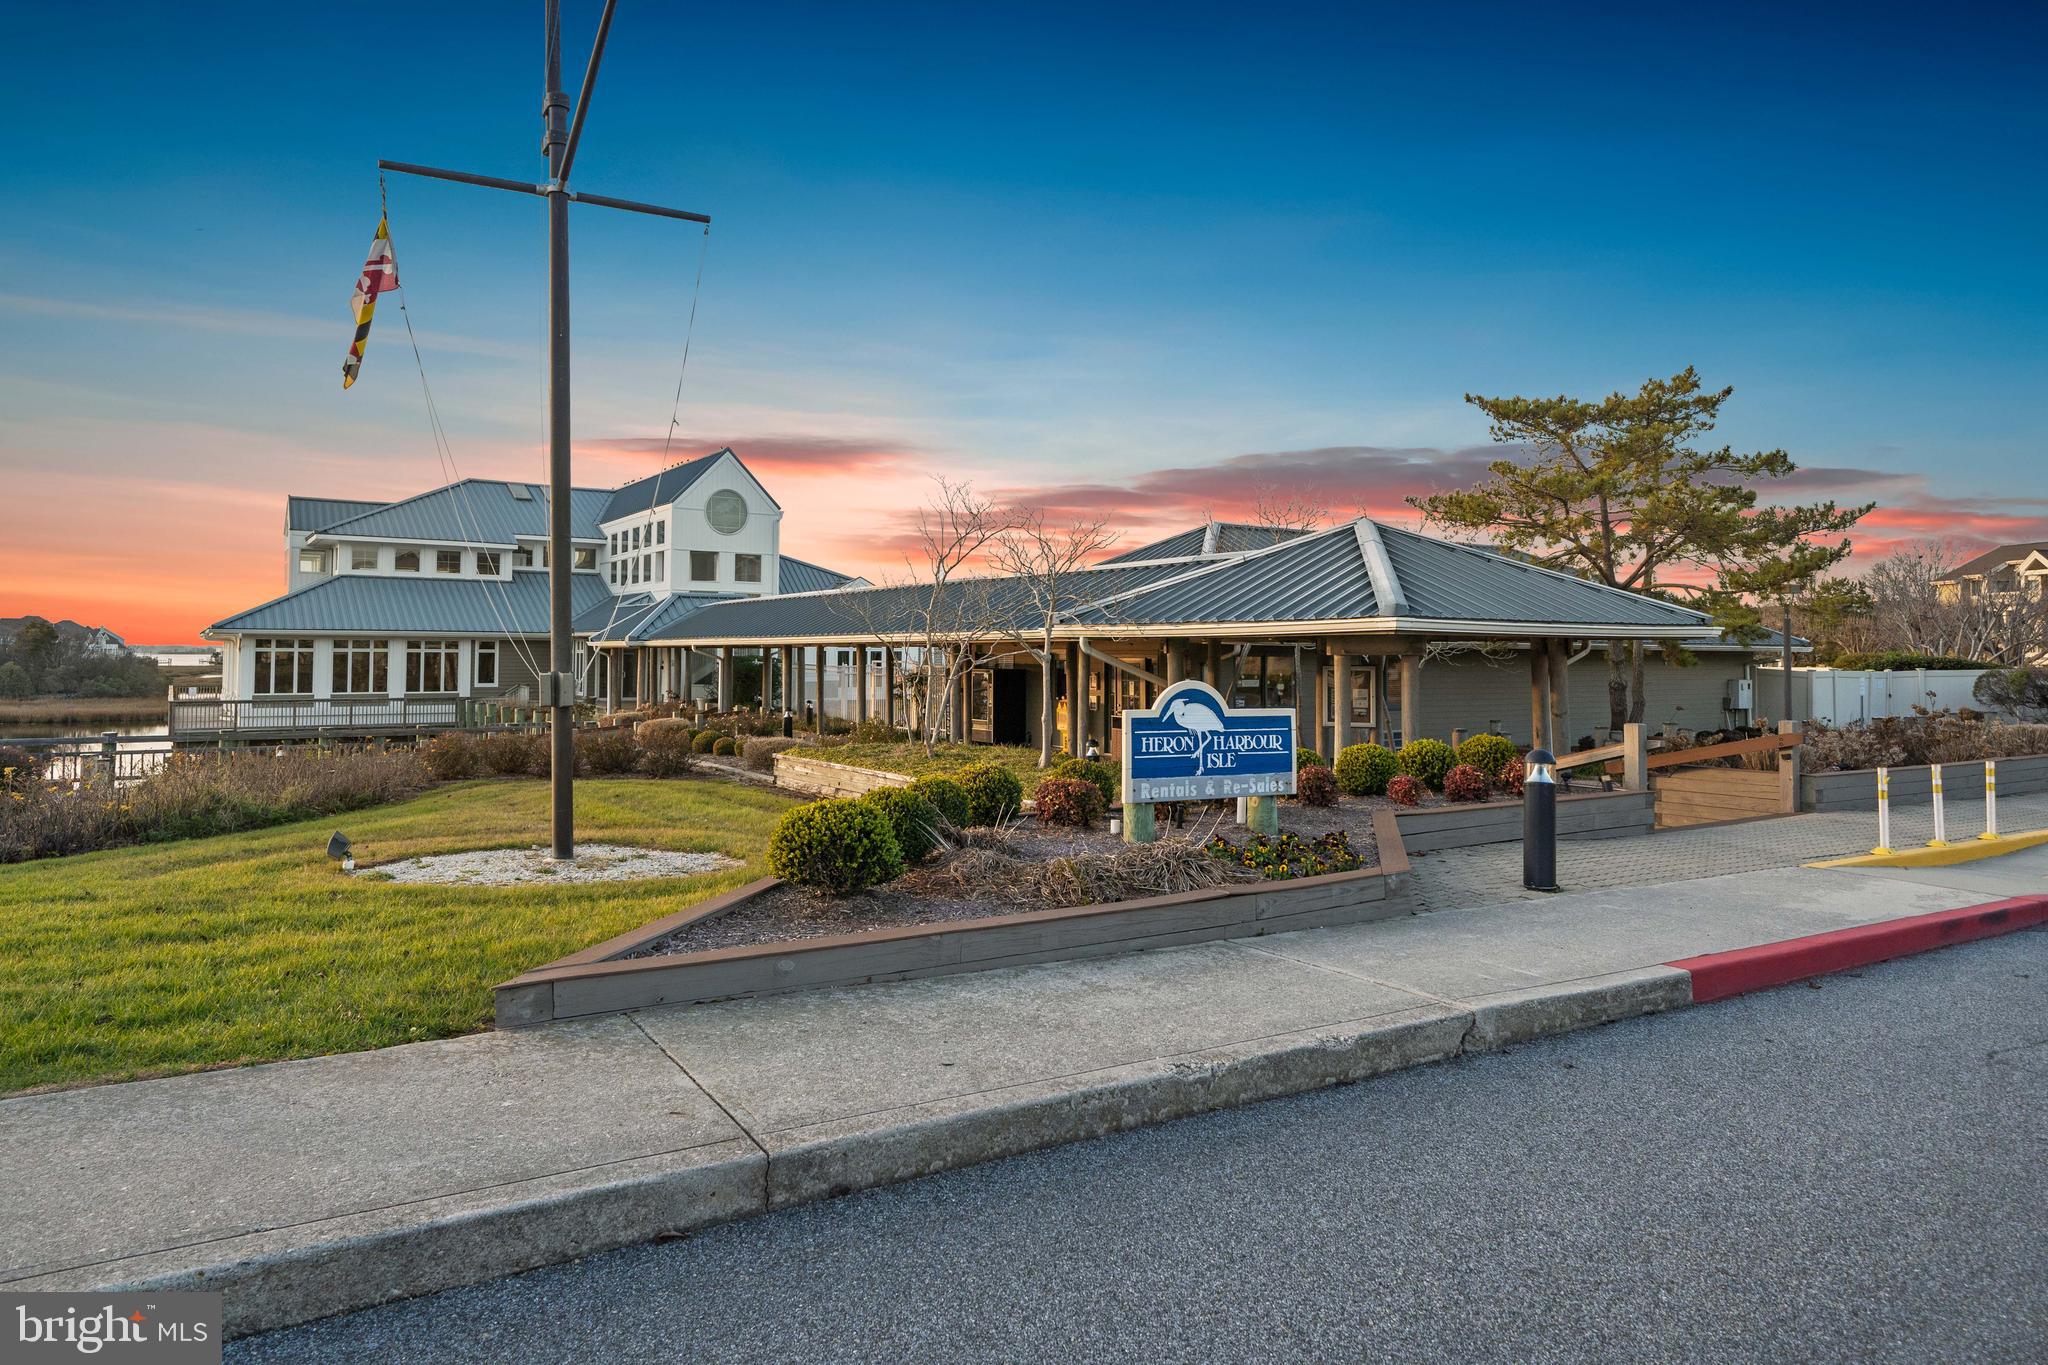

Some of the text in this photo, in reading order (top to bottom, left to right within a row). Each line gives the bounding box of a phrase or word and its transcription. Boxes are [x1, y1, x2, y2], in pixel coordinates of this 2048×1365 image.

[1141, 734, 1283, 753] HERON HARBOUR
[1207, 752, 1236, 768] ISLE
[1141, 777, 1285, 799] Rentals & Re-Sales
